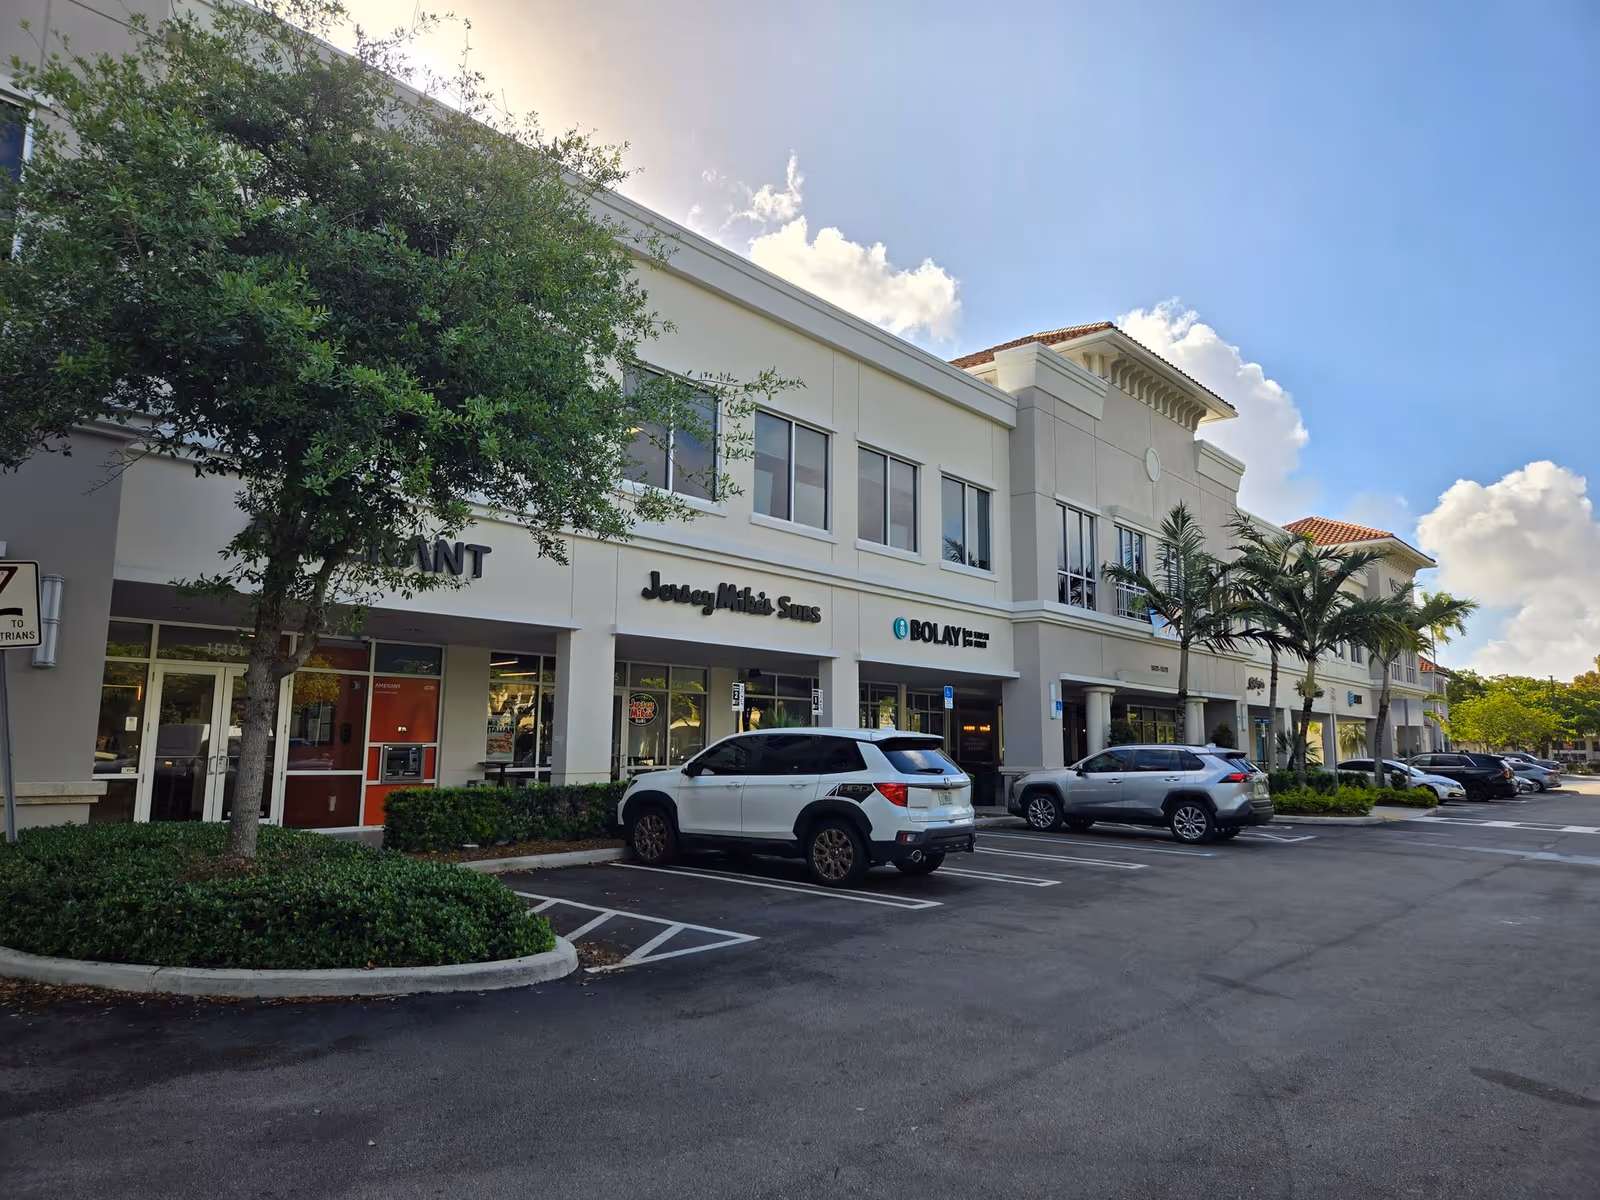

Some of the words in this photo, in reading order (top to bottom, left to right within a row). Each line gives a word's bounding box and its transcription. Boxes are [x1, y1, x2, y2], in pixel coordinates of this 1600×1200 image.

[641, 570, 716, 616] Jersey
[716, 582, 776, 616] Mike's
[11, 619, 24, 628] TO
[910, 619, 961, 647] BOLAY
[207, 642, 244, 657] 15151
